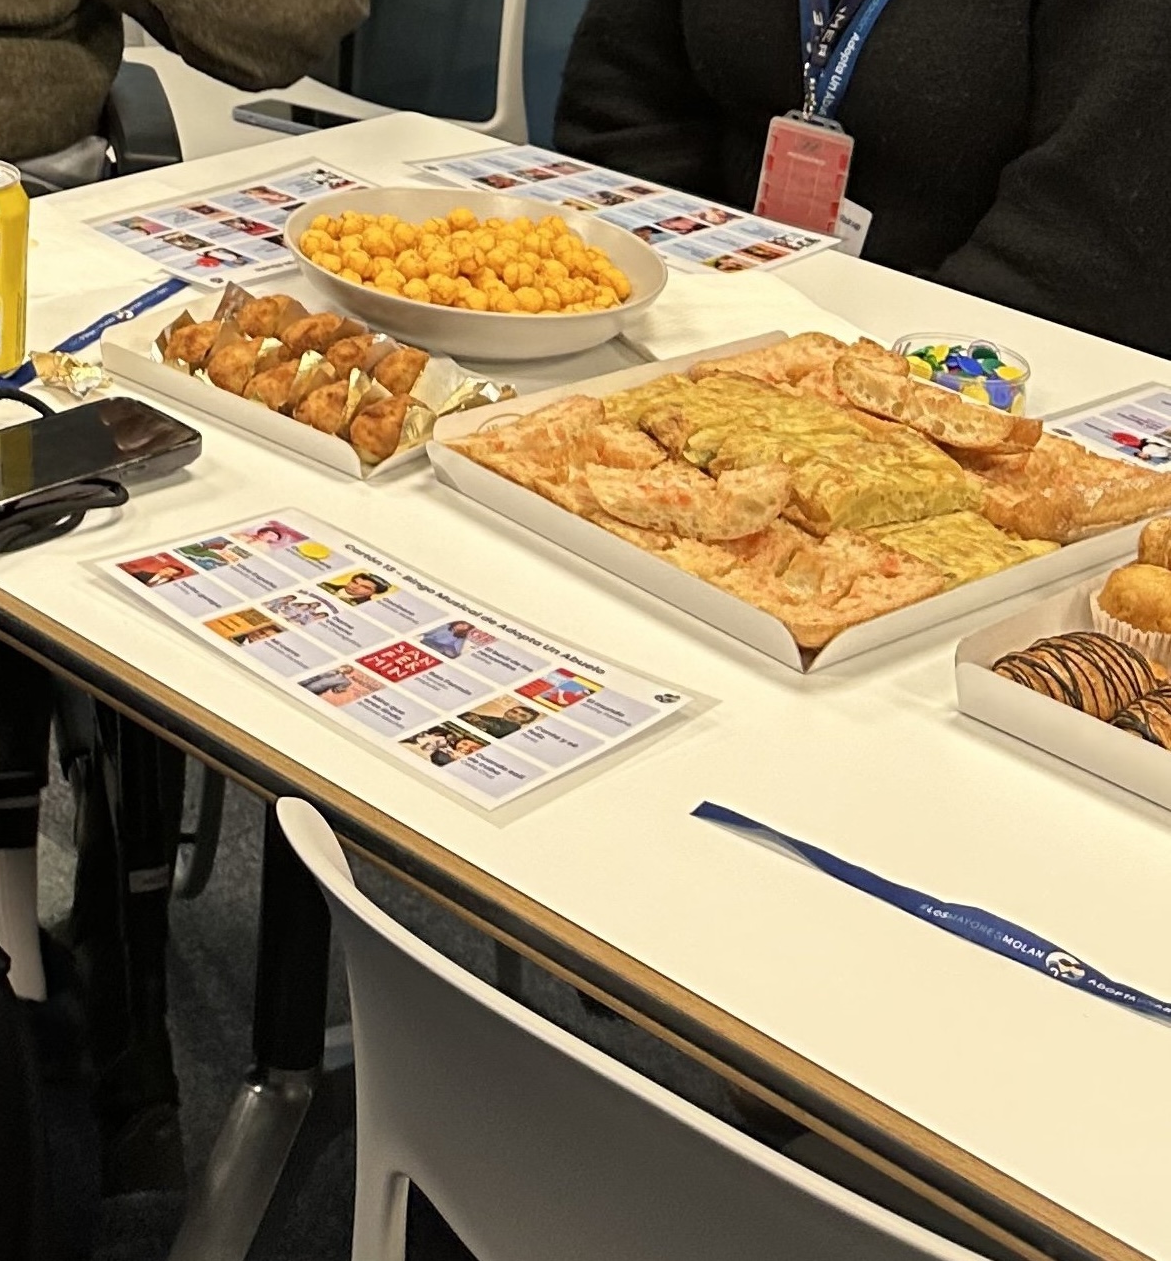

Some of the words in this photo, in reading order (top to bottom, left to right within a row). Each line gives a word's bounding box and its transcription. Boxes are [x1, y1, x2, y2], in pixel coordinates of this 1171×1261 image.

[834, 31, 860, 75] Adopta
[827, 74, 842, 92] Un
[435, 592, 483, 617] Musical
[480, 615, 497, 625] de
[496, 623, 543, 647] Adopta
[542, 644, 560, 655] Un
[560, 653, 606, 675] Abuelo
